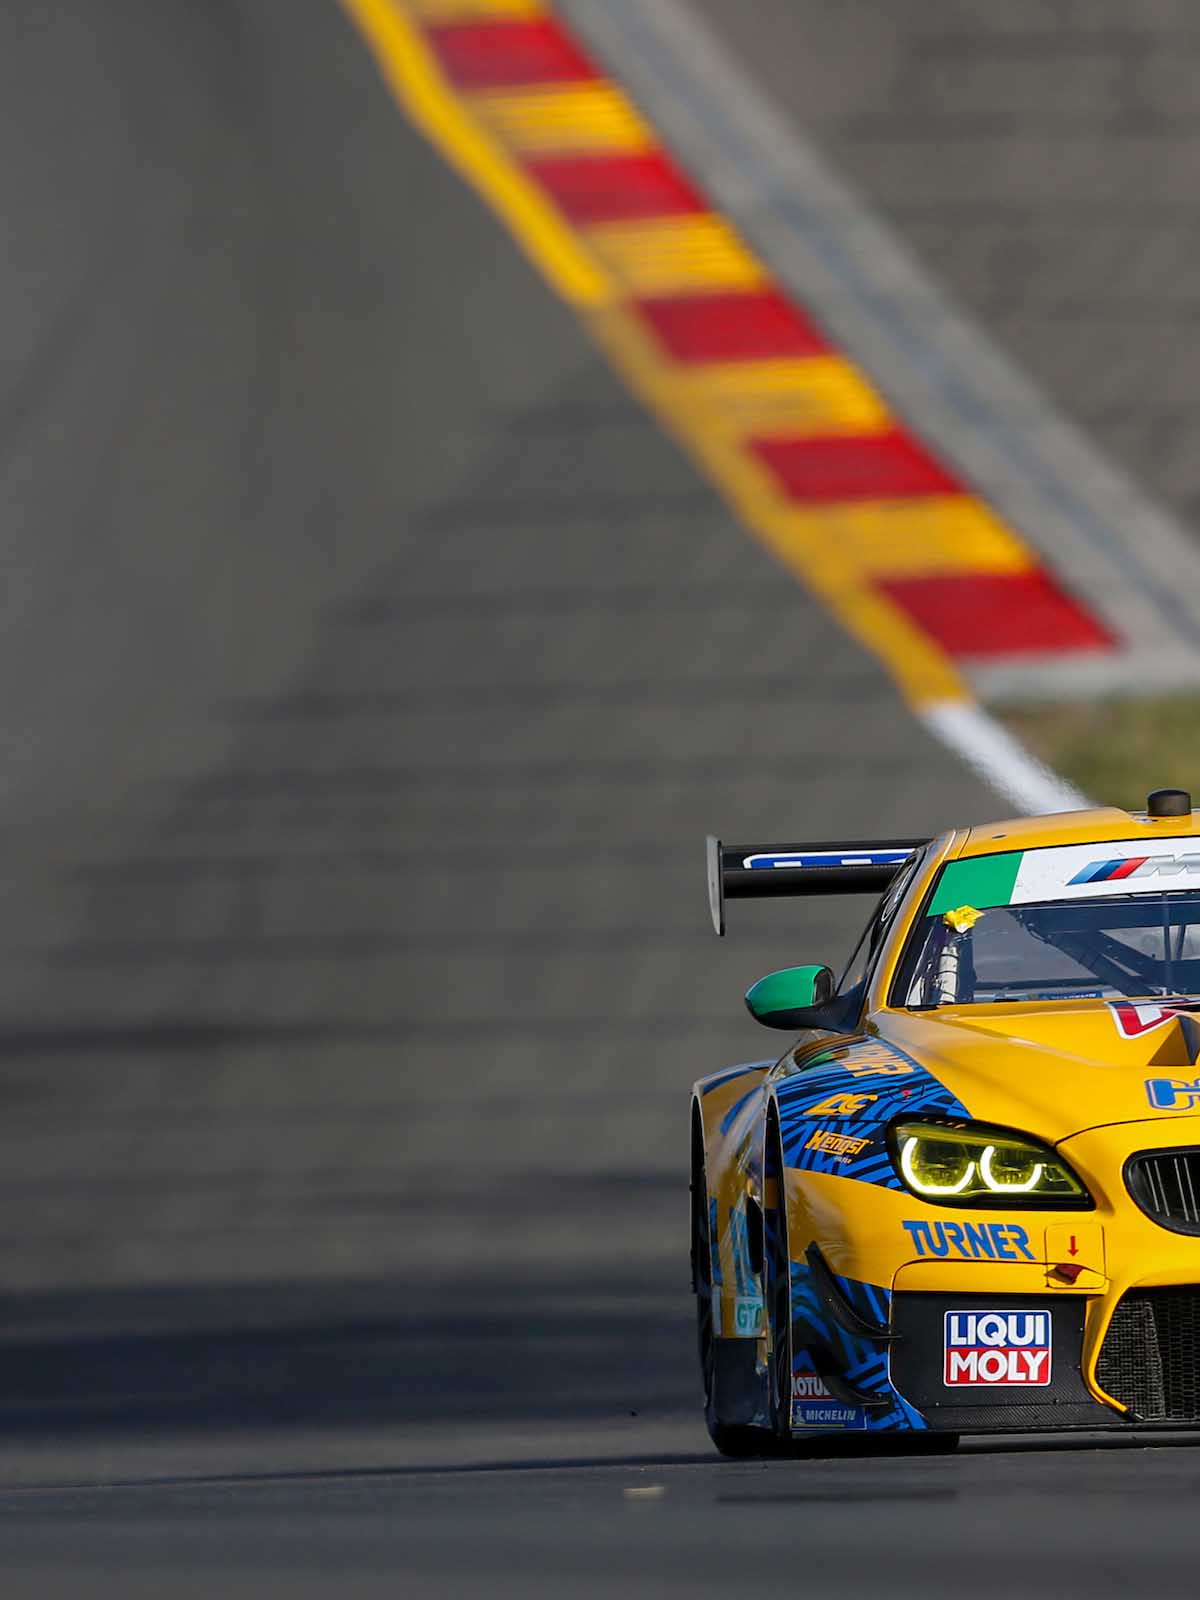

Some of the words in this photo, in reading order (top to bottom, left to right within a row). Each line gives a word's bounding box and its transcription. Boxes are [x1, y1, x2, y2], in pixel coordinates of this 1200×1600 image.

[902, 1220, 1037, 1260] TURNER
[950, 1314, 1046, 1347] LIQUI
[950, 1350, 1048, 1382] MOLY
[805, 1410, 857, 1422] MICHELIN
